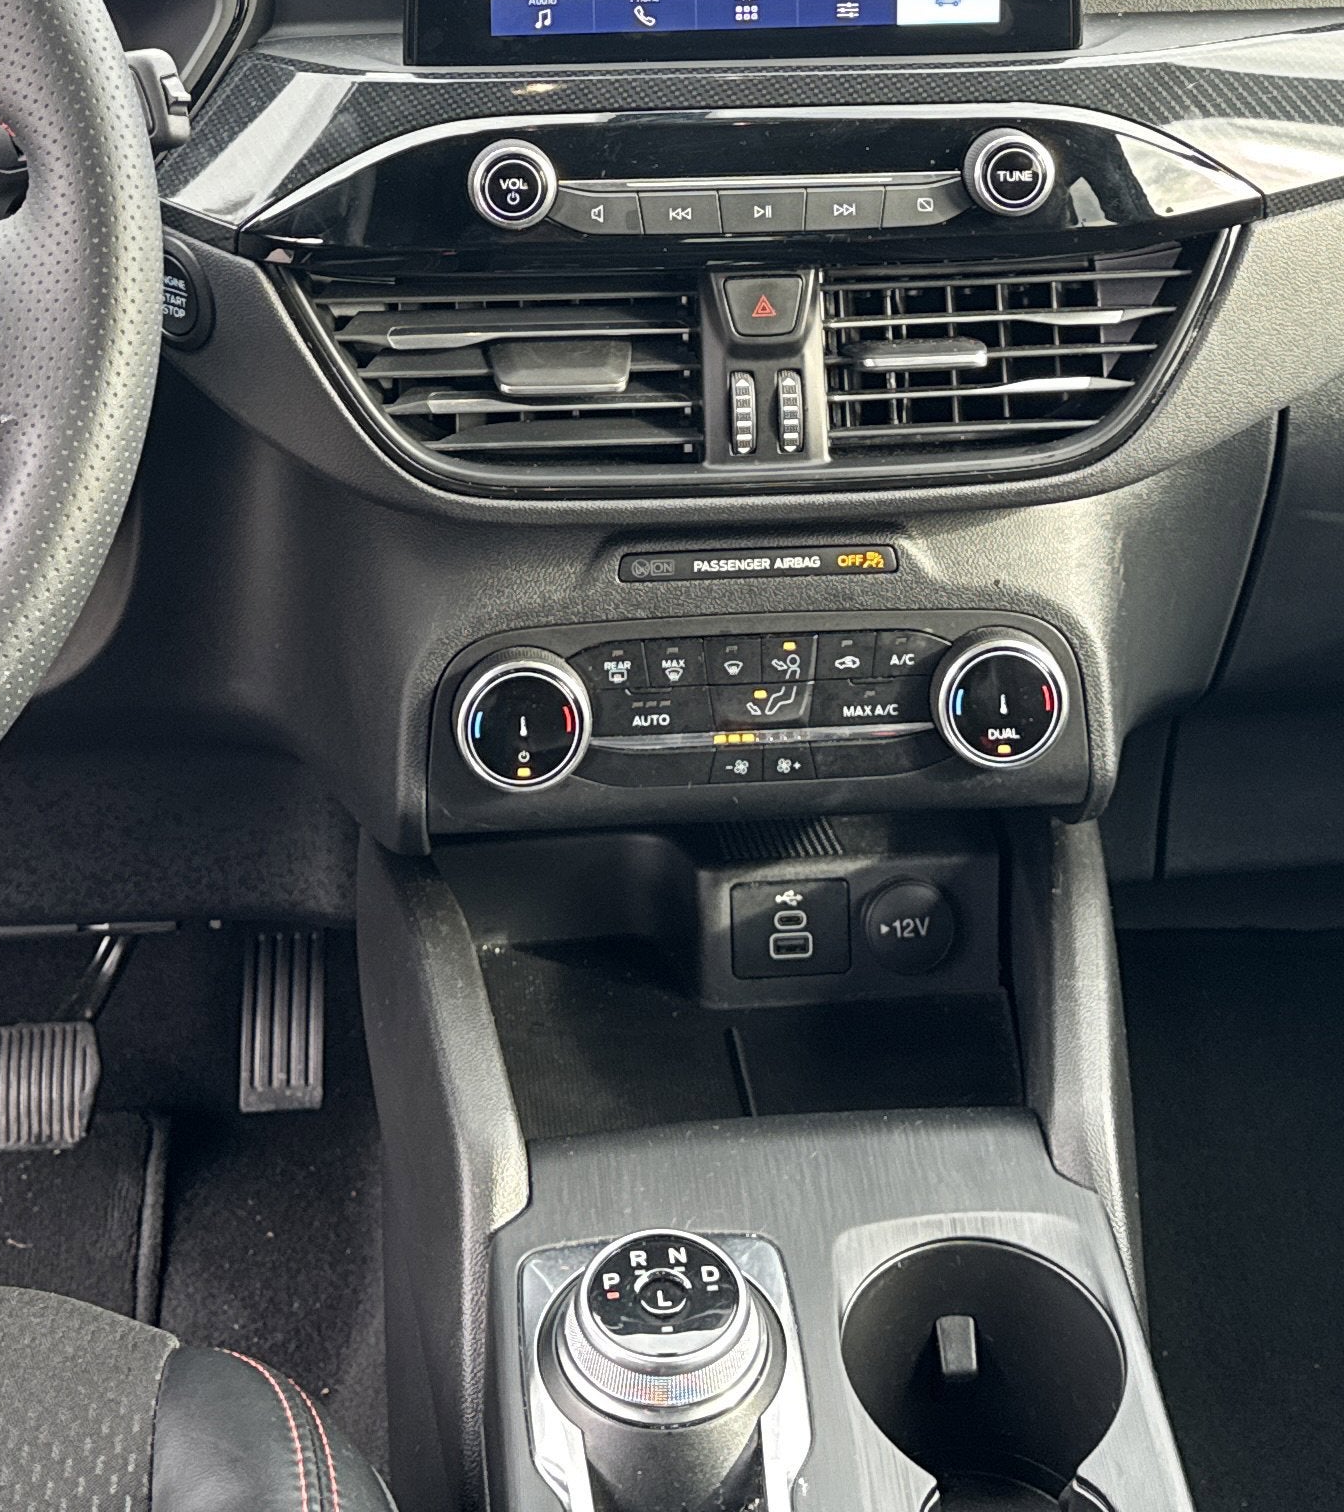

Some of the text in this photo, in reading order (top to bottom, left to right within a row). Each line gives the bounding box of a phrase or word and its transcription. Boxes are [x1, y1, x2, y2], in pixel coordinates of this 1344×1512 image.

[499, 178, 527, 190] VOL
[997, 170, 1033, 183] TUNE
[163, 292, 187, 308] TART
[693, 558, 770, 573] PASSENGER
[774, 555, 821, 569] AIRBAG
[837, 554, 864, 568] OFF
[604, 660, 632, 671] REAR
[661, 658, 686, 669] MAX
[889, 652, 915, 667] A/C
[842, 703, 899, 718] MAX A/C
[632, 714, 670, 728] AUTO
[987, 728, 1021, 740] DUAL
[892, 916, 930, 939] 12V
[629, 1250, 648, 1267] R
[667, 1246, 688, 1264] N
[602, 1272, 621, 1290] P
[700, 1265, 720, 1283] D
[656, 1289, 673, 1307] L
